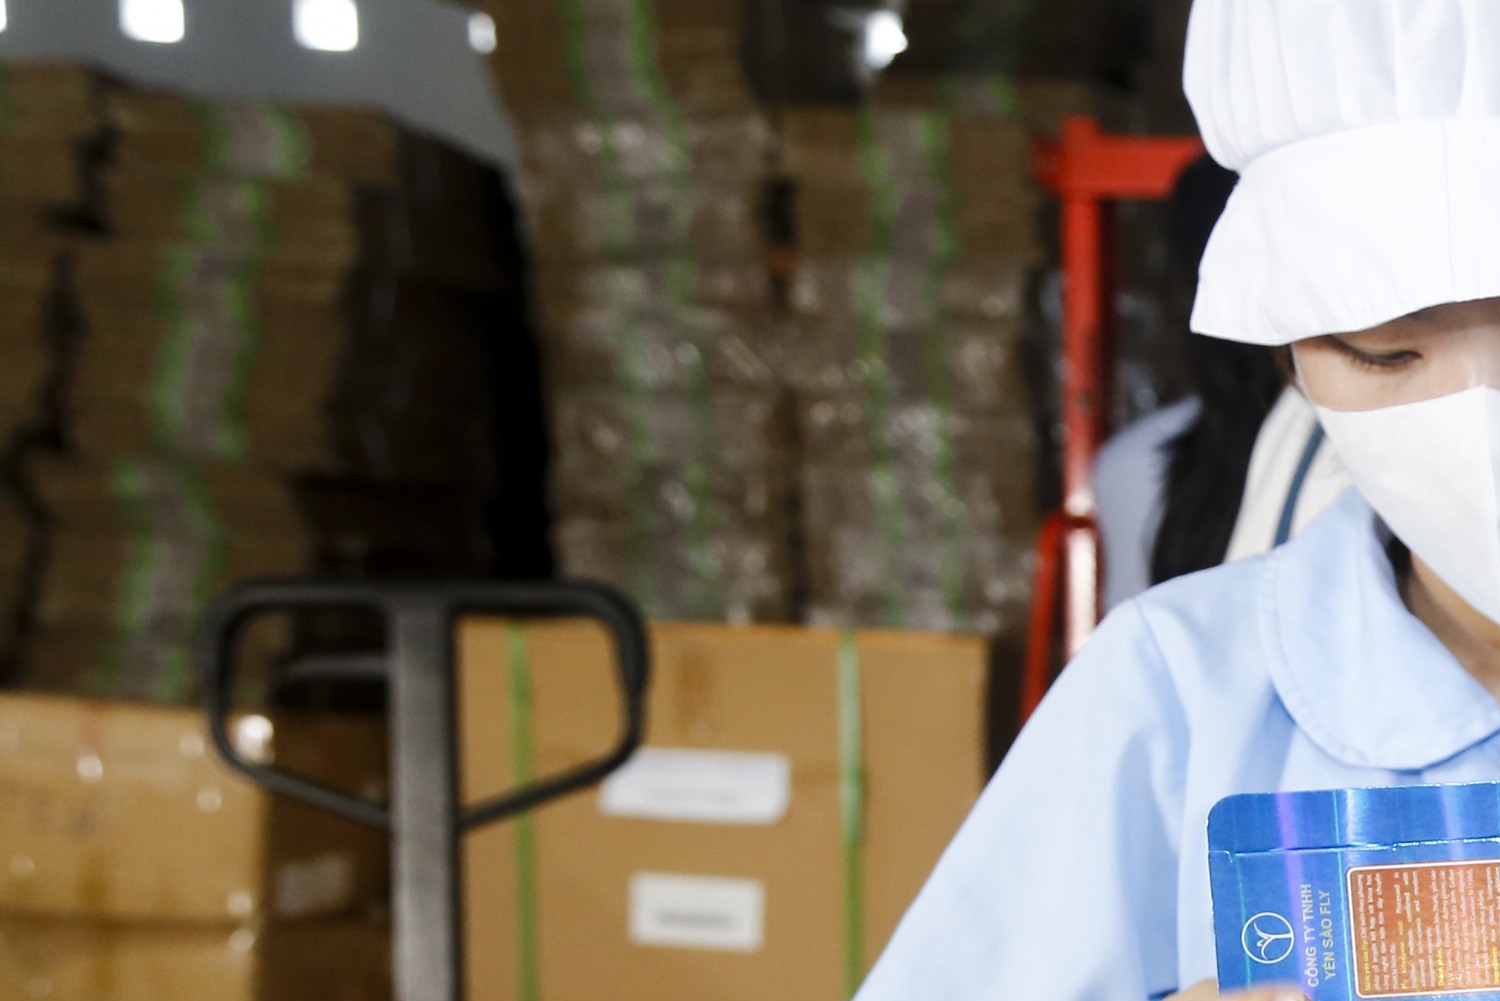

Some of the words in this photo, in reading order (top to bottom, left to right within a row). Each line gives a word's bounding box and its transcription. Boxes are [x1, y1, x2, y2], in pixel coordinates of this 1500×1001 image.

[1301, 884, 1314, 922] TNHH
[1319, 890, 1331, 914] FLY
[1304, 925, 1315, 943] TY
[1319, 918, 1334, 948] SÀO
[1304, 947, 1319, 987] CÔNG
